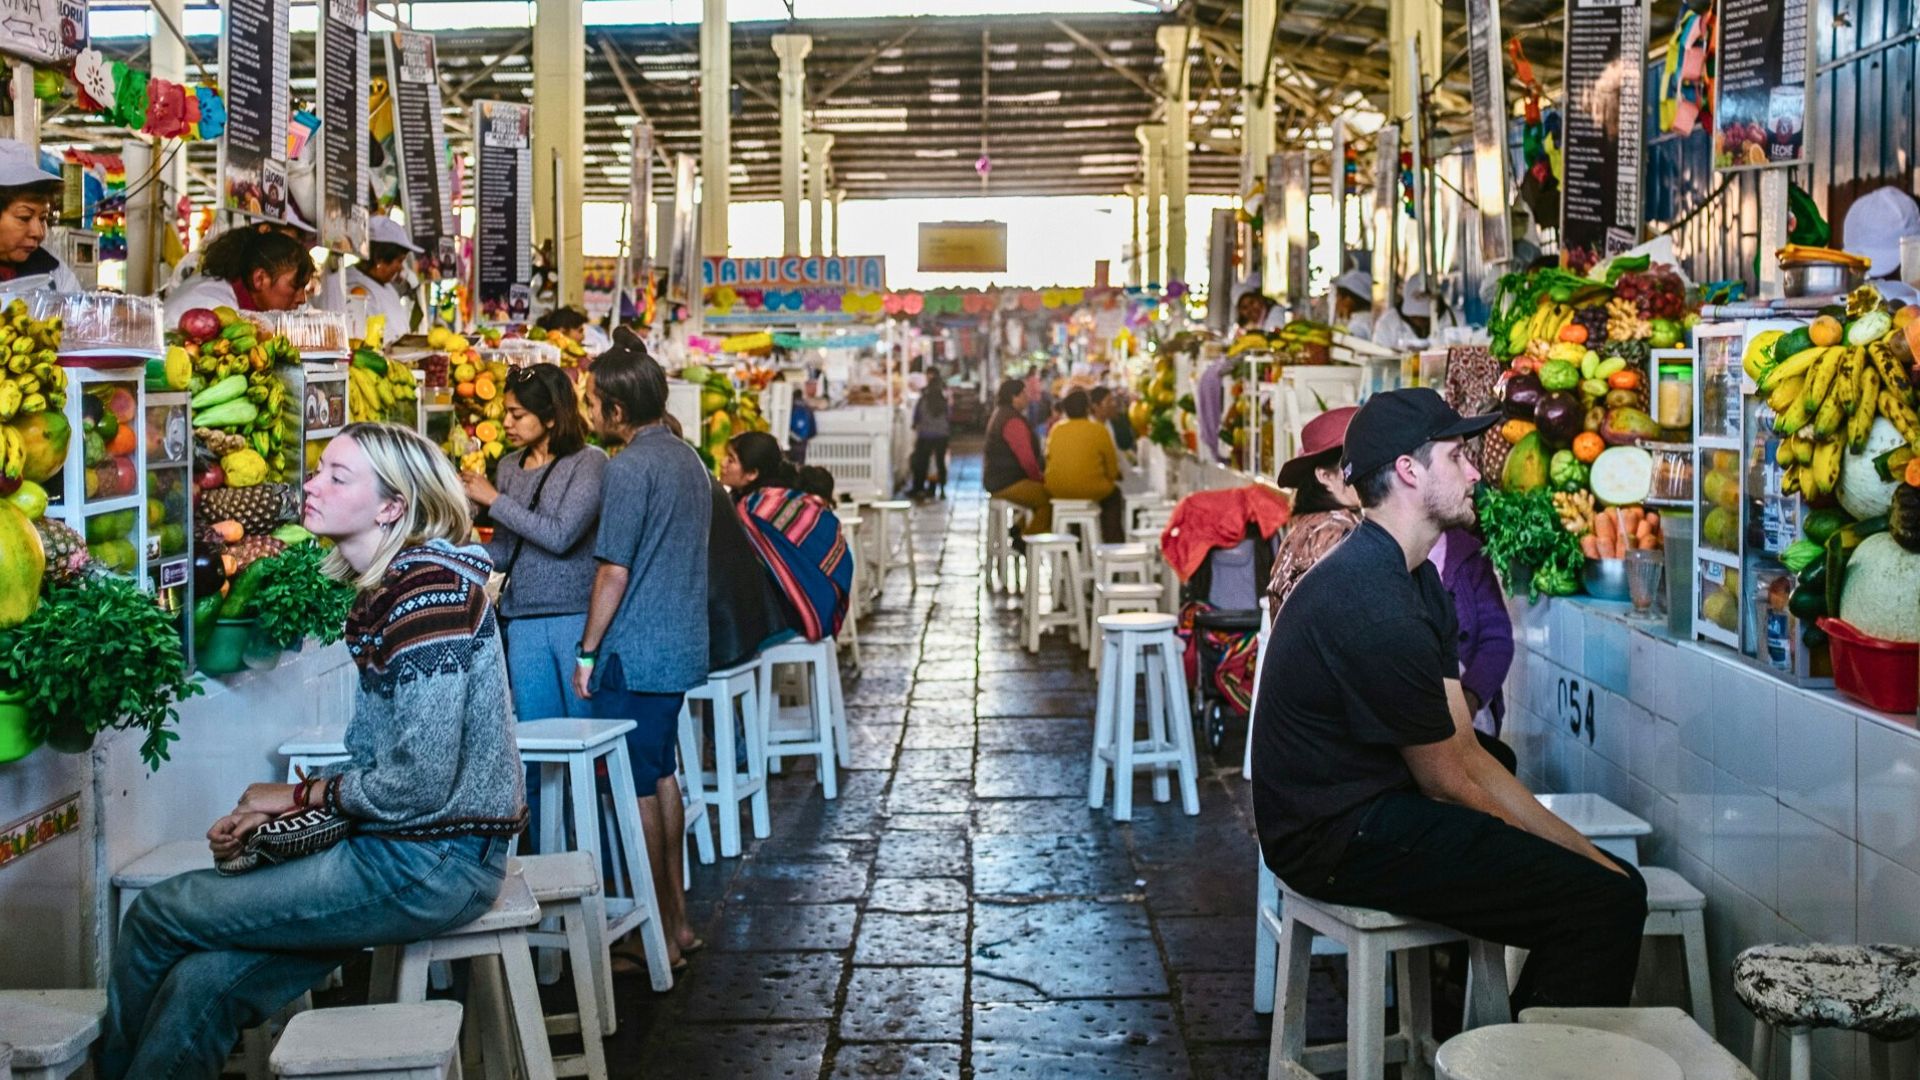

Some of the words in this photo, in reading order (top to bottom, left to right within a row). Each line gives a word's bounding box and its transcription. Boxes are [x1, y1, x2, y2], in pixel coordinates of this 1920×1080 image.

[38, 27, 57, 56] 59
[703, 259, 880, 289] ARNICERIA
[1558, 677, 1595, 747] 054
